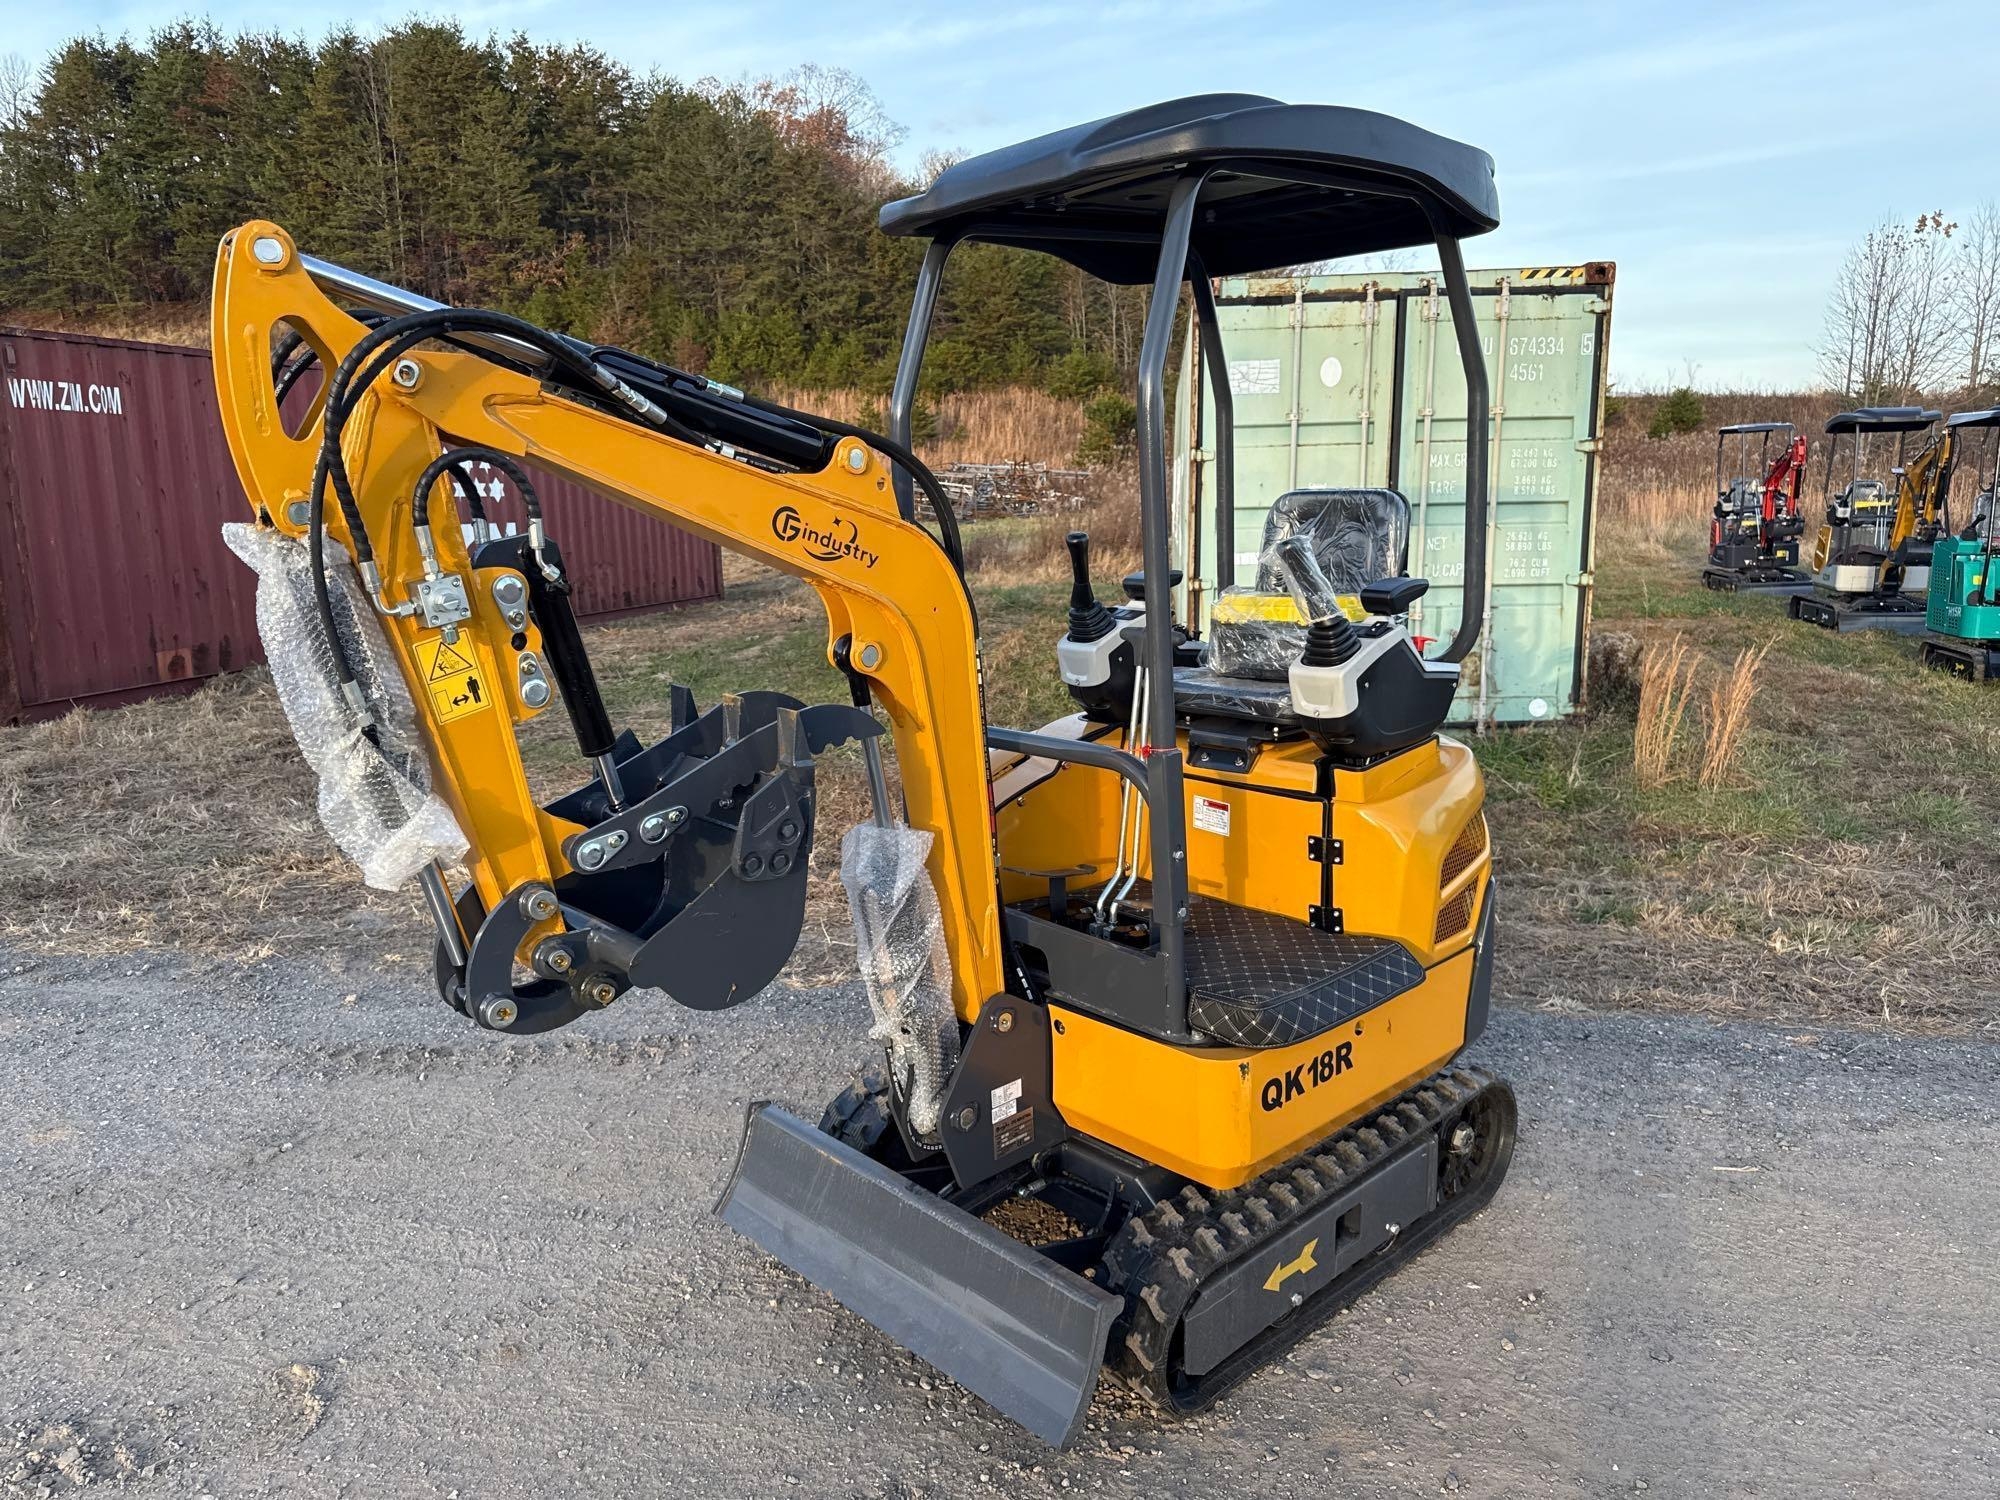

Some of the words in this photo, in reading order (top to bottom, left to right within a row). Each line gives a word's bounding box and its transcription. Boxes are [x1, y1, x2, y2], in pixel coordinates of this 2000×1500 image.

[1510, 337, 1565, 356] 674334
[1582, 335, 1593, 354] 5
[1509, 363, 1544, 382] 4561
[1429, 480, 1457, 495] TARE
[1426, 536, 1448, 551] NET
[1261, 1040, 1354, 1112] QK18R
